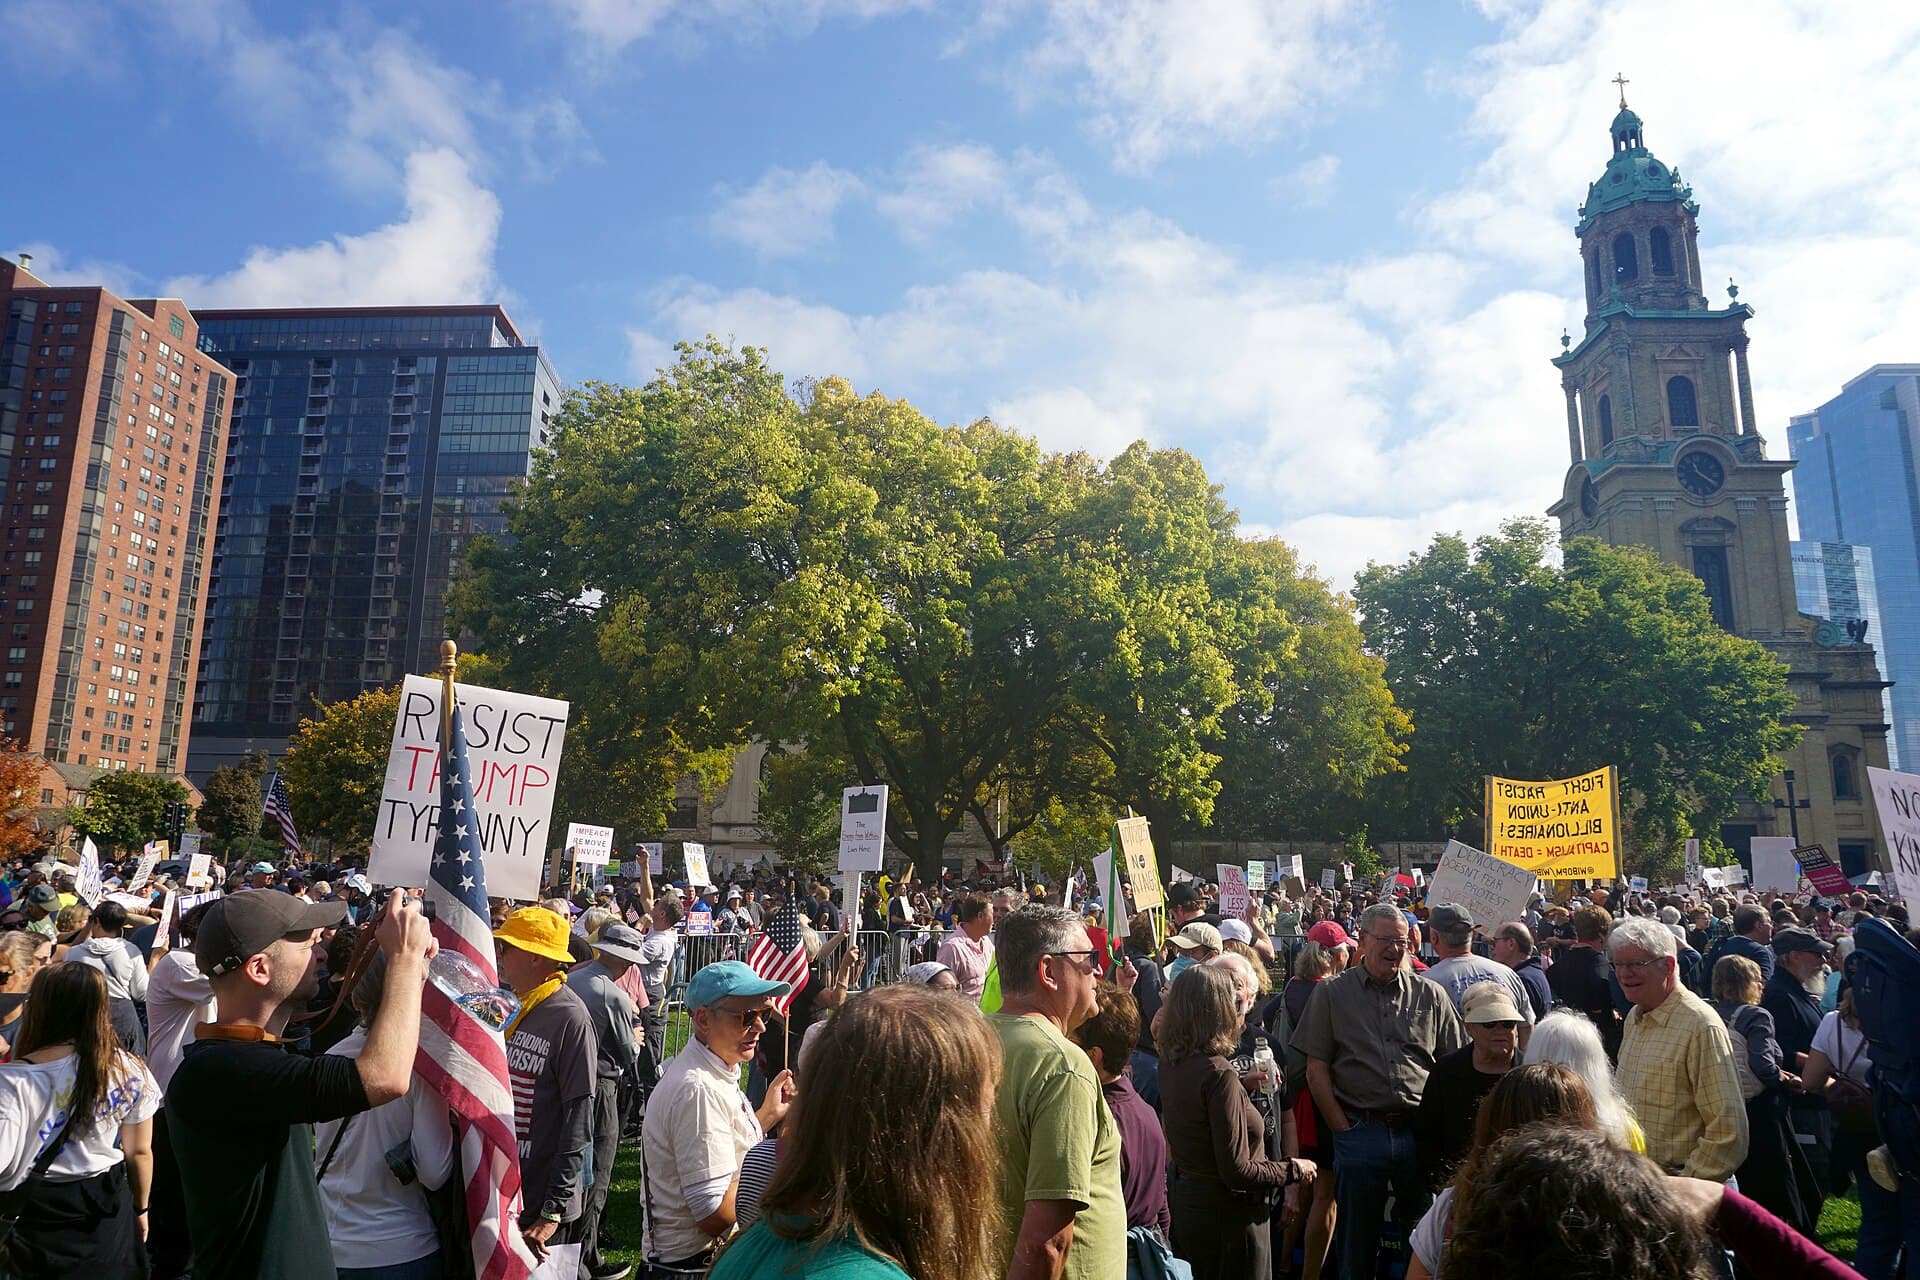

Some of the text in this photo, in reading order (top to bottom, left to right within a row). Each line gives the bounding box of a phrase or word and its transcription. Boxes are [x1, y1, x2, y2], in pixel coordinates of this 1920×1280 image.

[400, 692, 566, 759] RSIST
[575, 827, 610, 838] IMPEACH
[573, 837, 607, 848] REMOVE
[1457, 846, 1535, 888] DEMOCRACY
[1481, 873, 1503, 891] FEAR
[1464, 881, 1511, 907] PROTEST
[1227, 897, 1244, 910] LESS
